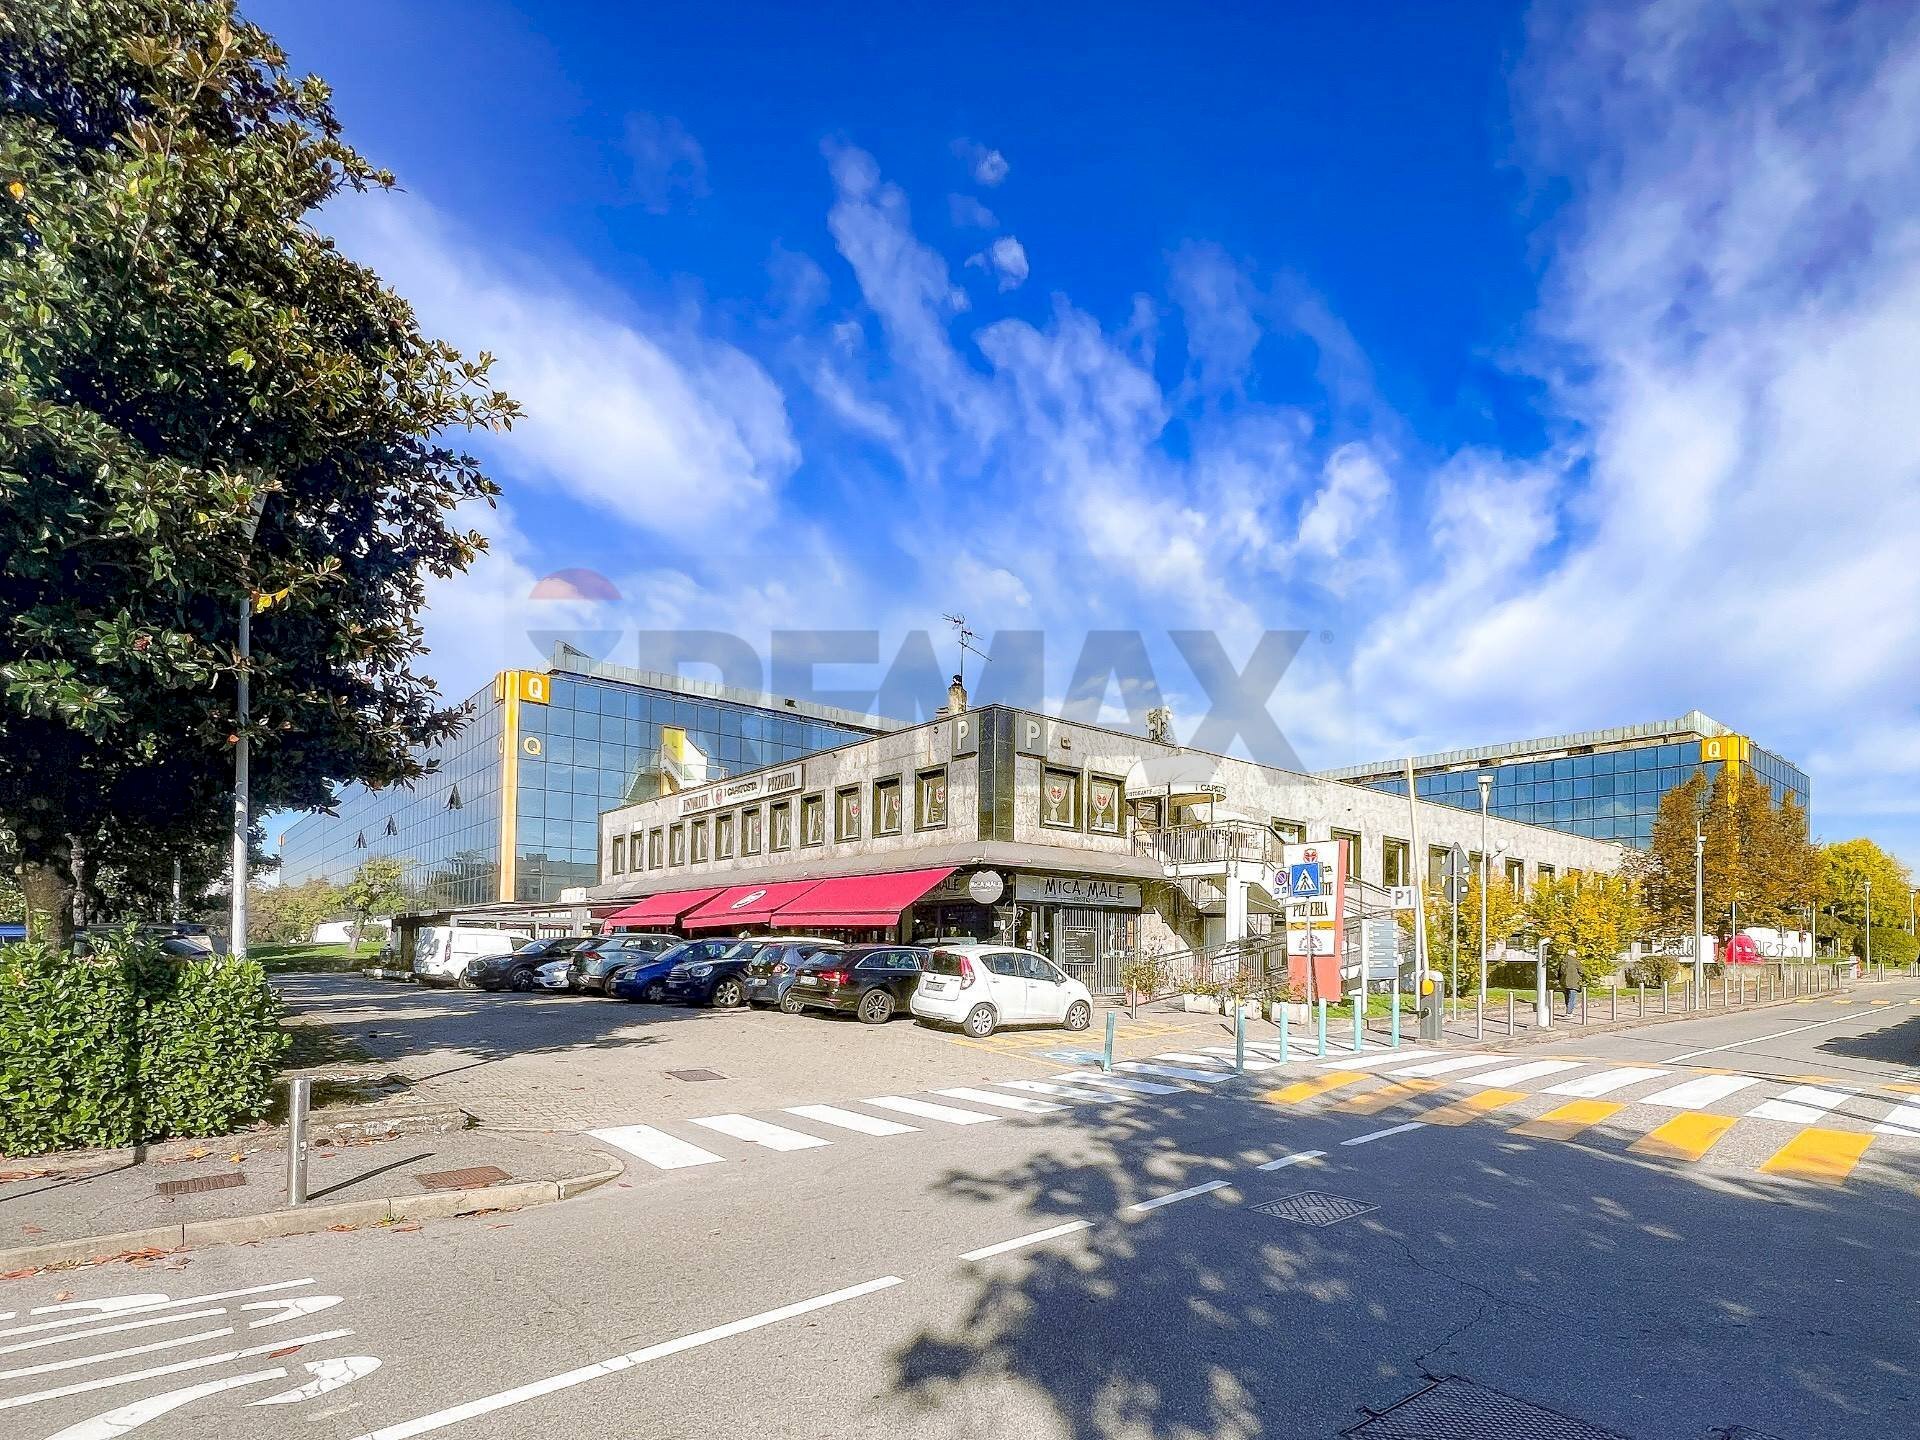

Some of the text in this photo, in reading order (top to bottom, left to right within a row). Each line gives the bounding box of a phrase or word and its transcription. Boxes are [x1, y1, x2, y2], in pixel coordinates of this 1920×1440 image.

[527, 677, 544, 701] Q
[957, 720, 970, 750] P
[1026, 719, 1041, 749] P
[523, 736, 542, 756] Q
[1707, 741, 1722, 759] Q
[1087, 882, 1125, 899] MALE
[1394, 889, 1412, 906] P1
[1293, 901, 1328, 917] PIZERIA
